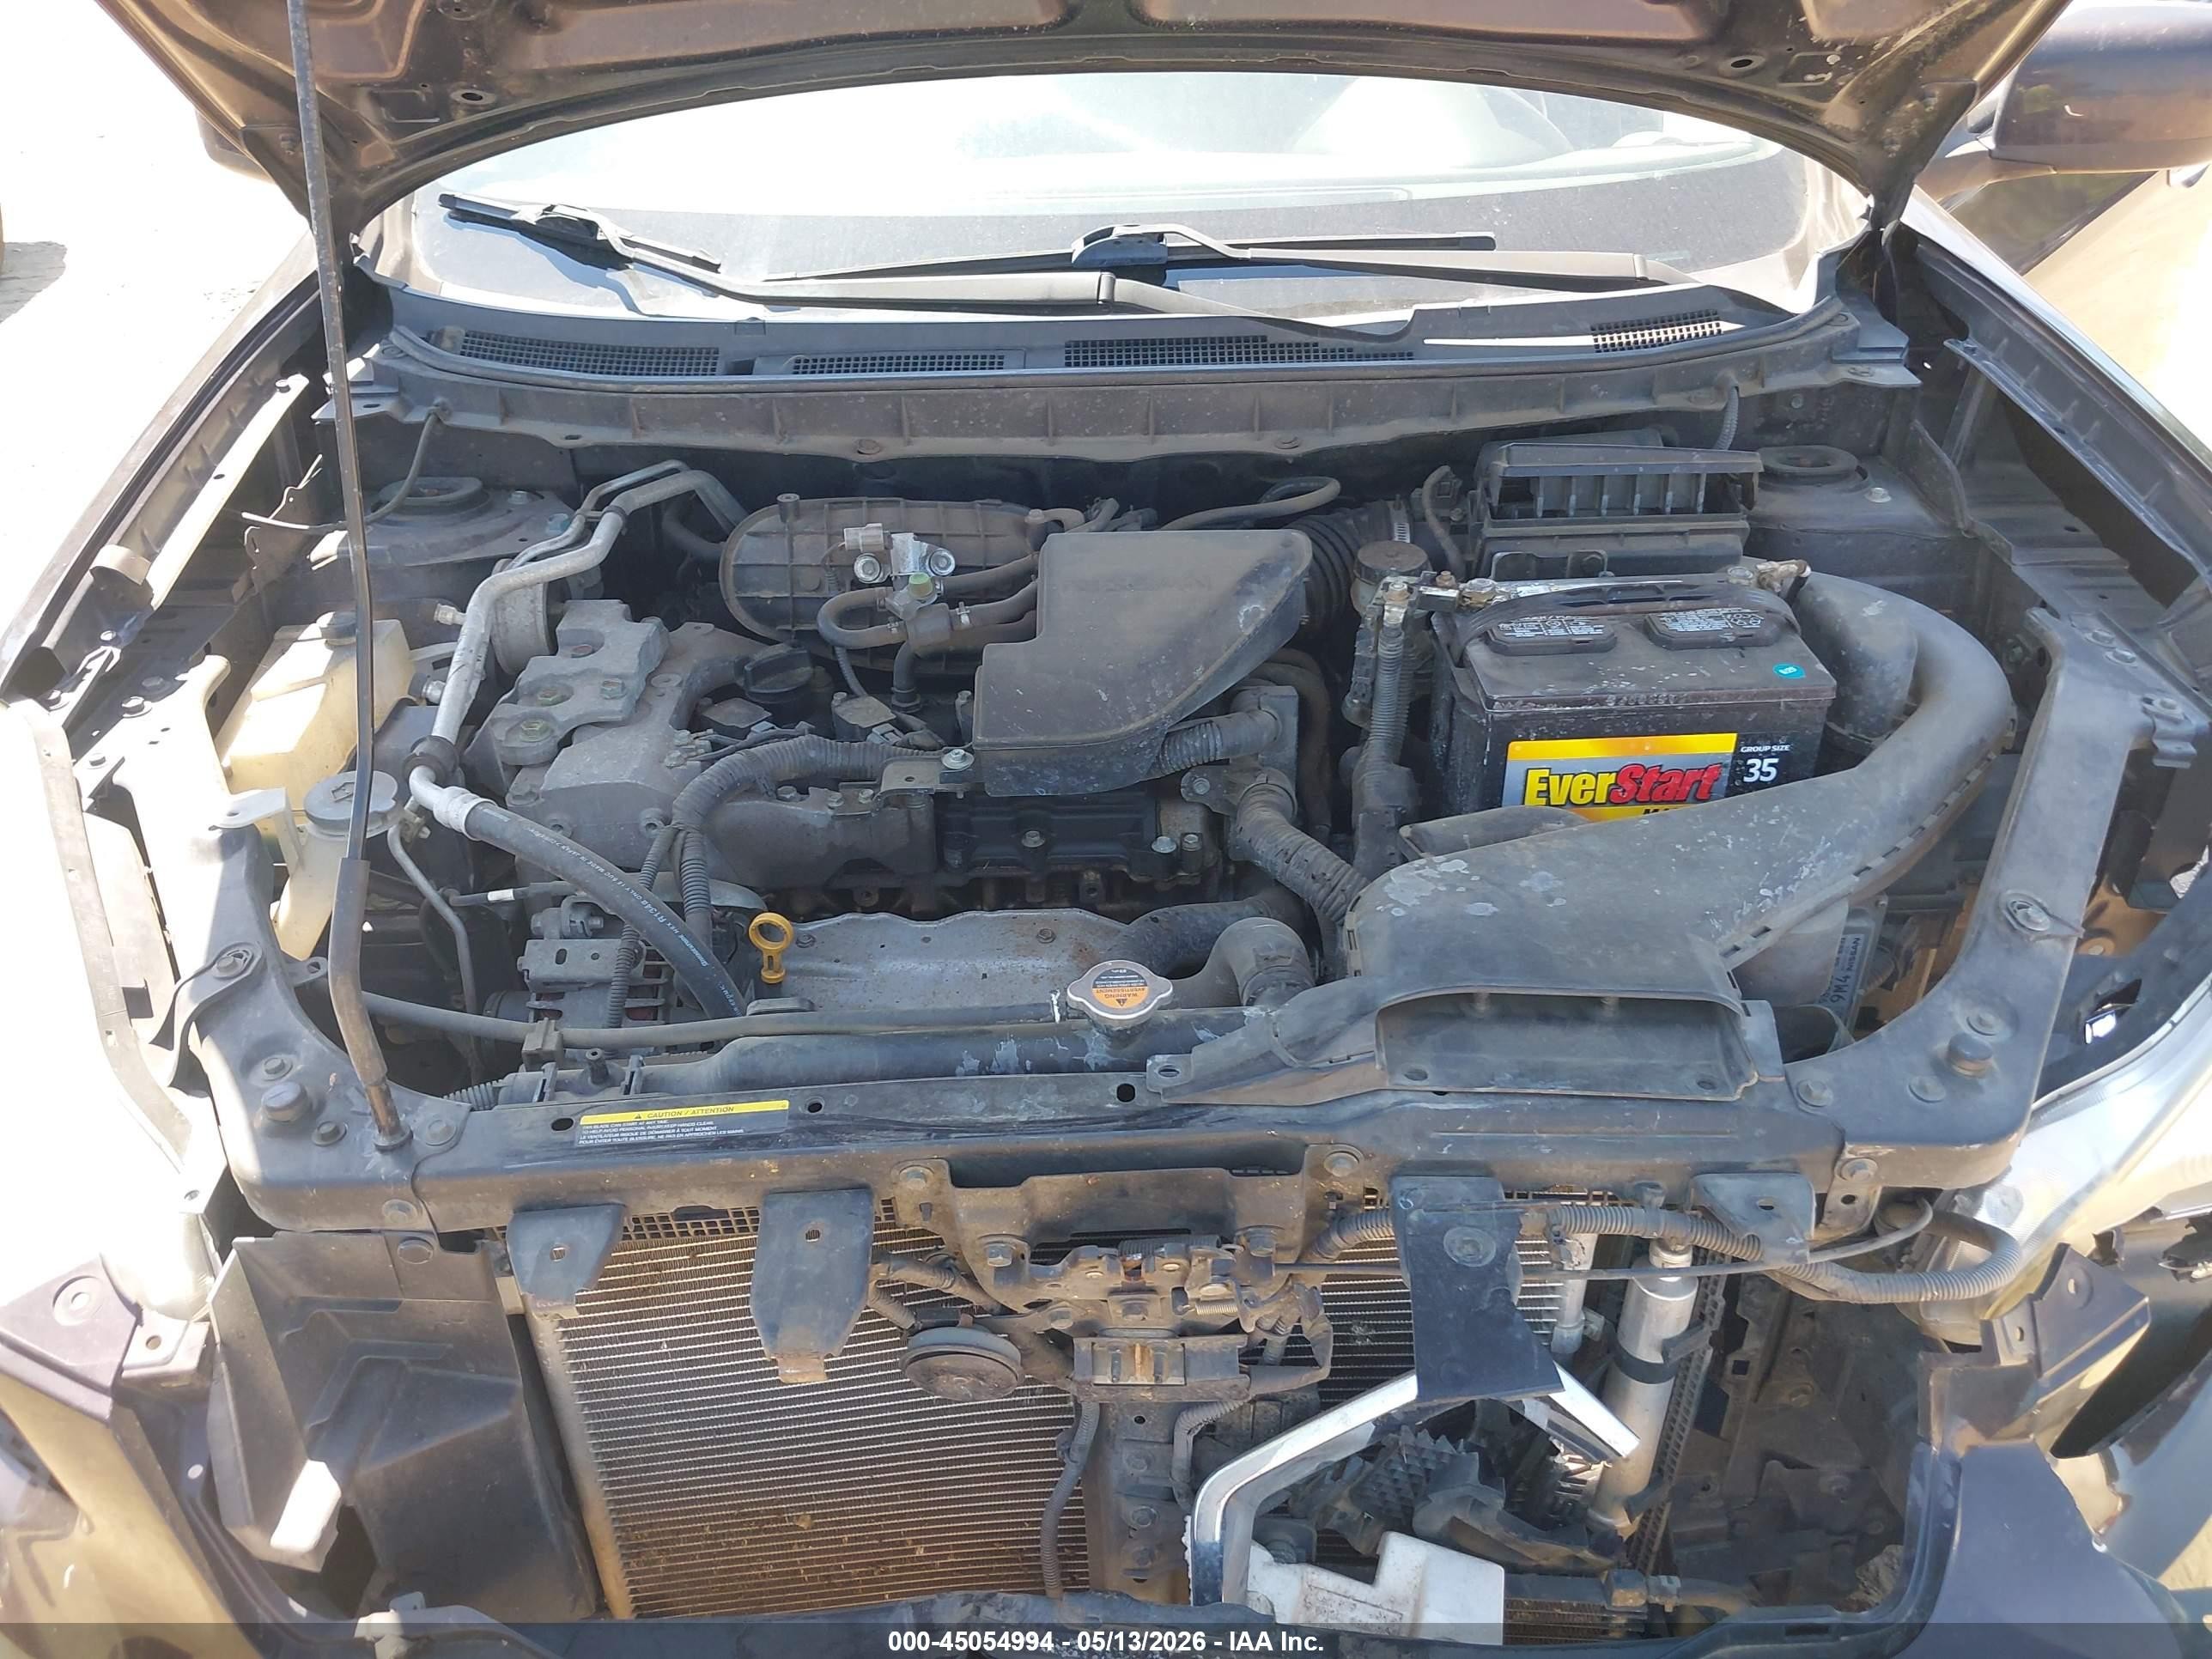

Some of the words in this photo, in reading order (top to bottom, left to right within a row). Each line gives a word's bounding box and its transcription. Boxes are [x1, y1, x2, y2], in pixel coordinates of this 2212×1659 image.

[1523, 763, 1723, 805] EverStart
[1743, 757, 1779, 782] 35
[1846, 937, 1862, 971] NISSAN
